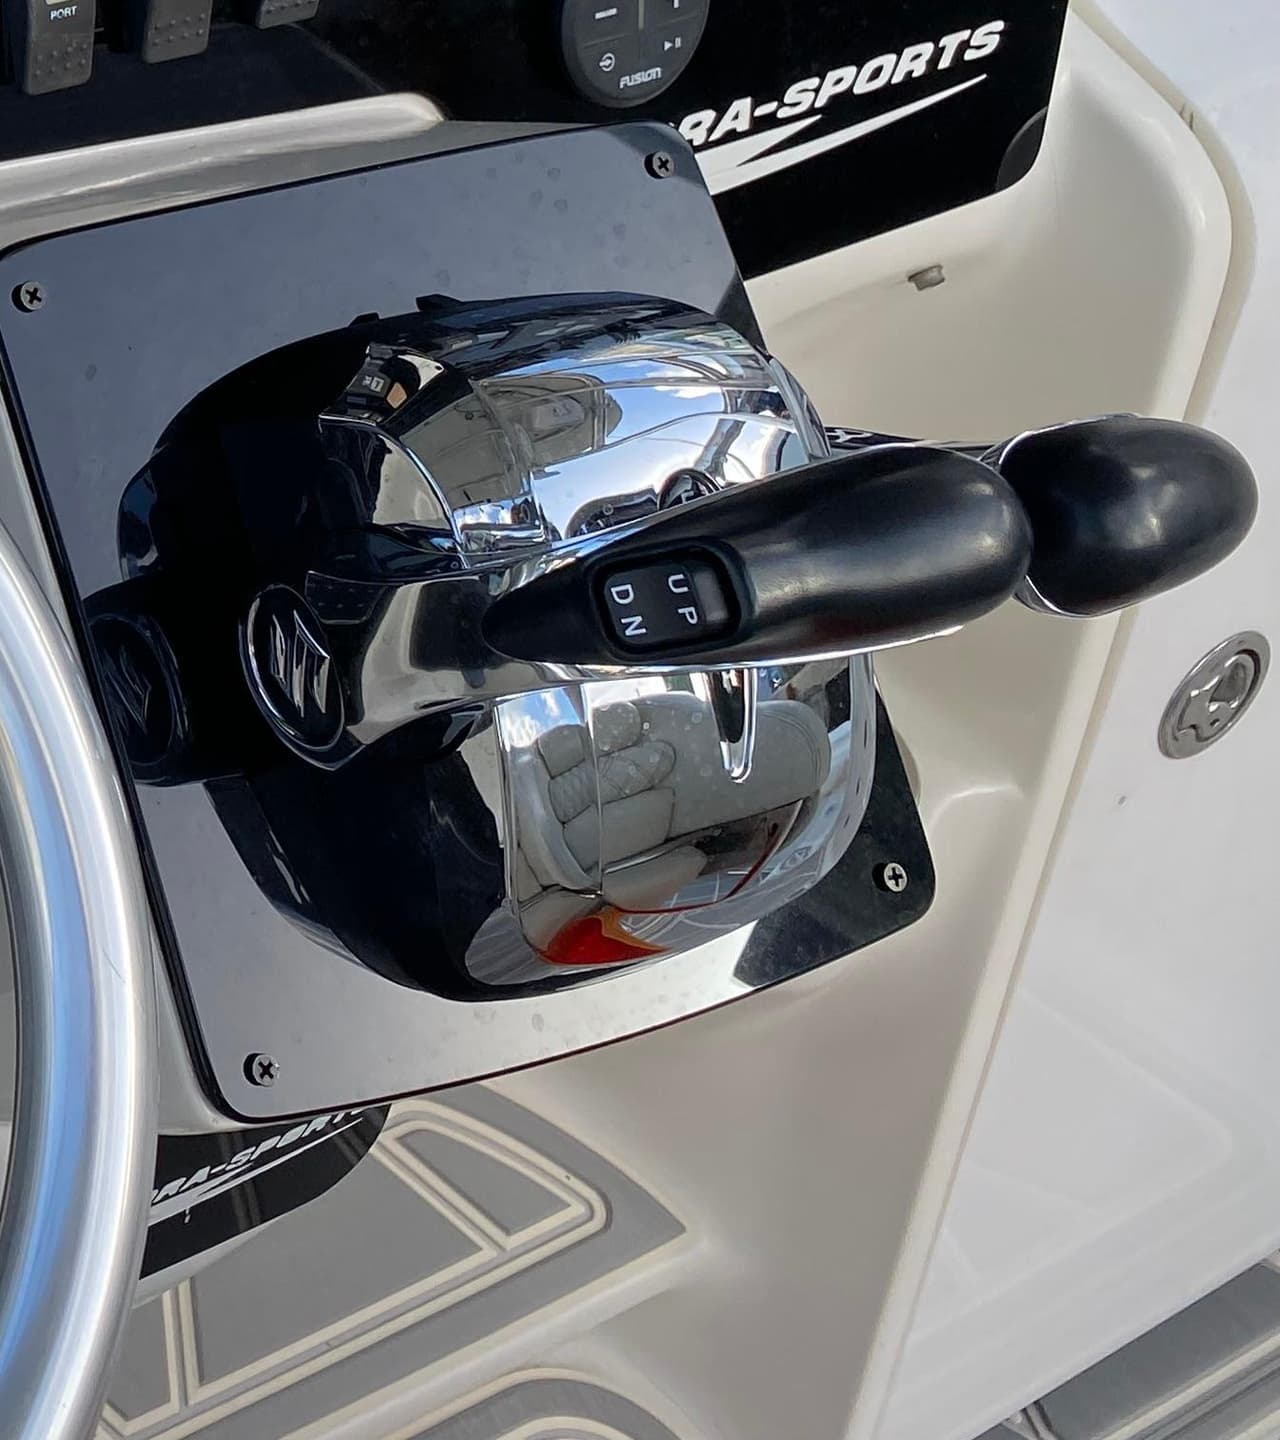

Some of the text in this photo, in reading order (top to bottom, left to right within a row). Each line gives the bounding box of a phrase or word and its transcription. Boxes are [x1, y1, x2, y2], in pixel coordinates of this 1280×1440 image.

[50, 5, 78, 21] PORT
[674, 20, 1005, 147] RA-SPORTS
[610, 583, 647, 636] DN
[667, 573, 698, 625] UP
